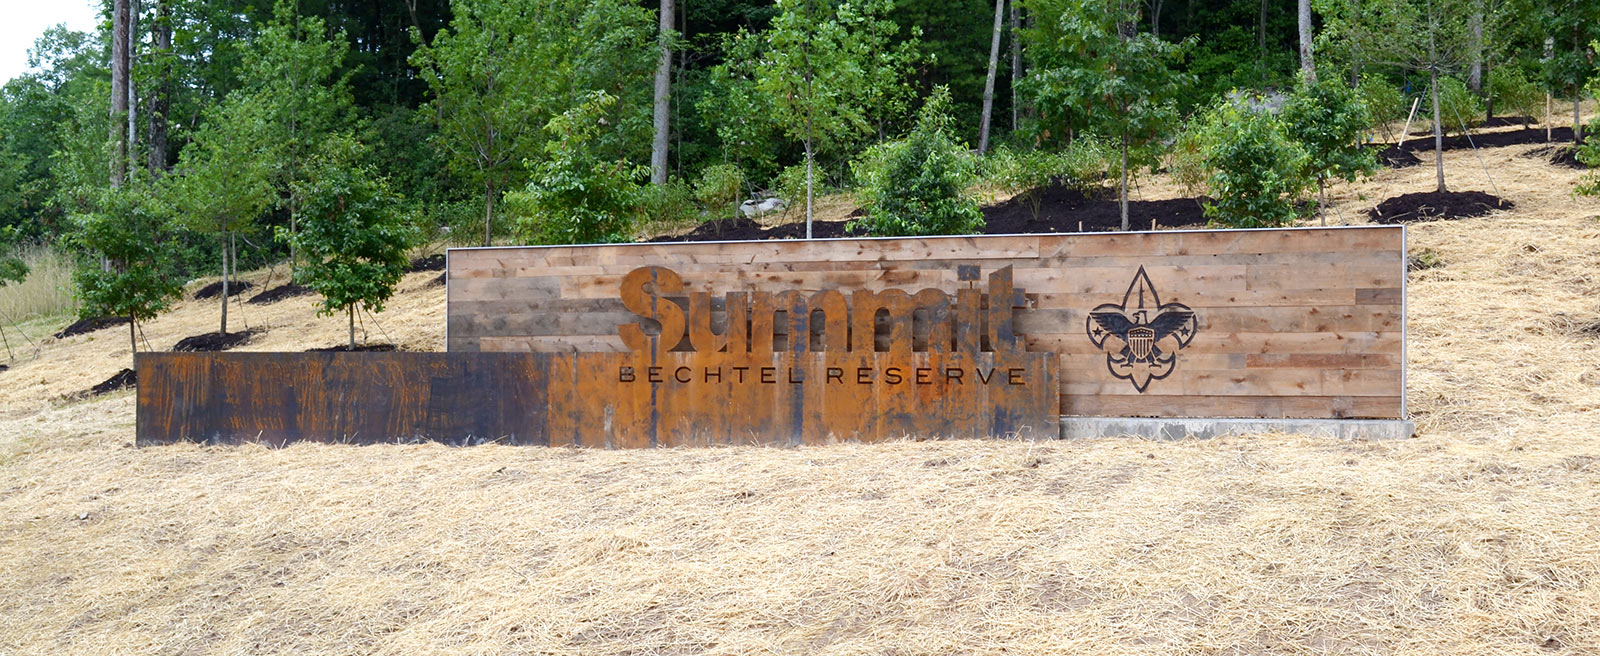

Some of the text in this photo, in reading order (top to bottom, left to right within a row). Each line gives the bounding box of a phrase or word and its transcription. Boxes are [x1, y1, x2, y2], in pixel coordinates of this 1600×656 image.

[618, 264, 1026, 353] Summit
[619, 366, 1026, 386] BECHTEL RESERVE
